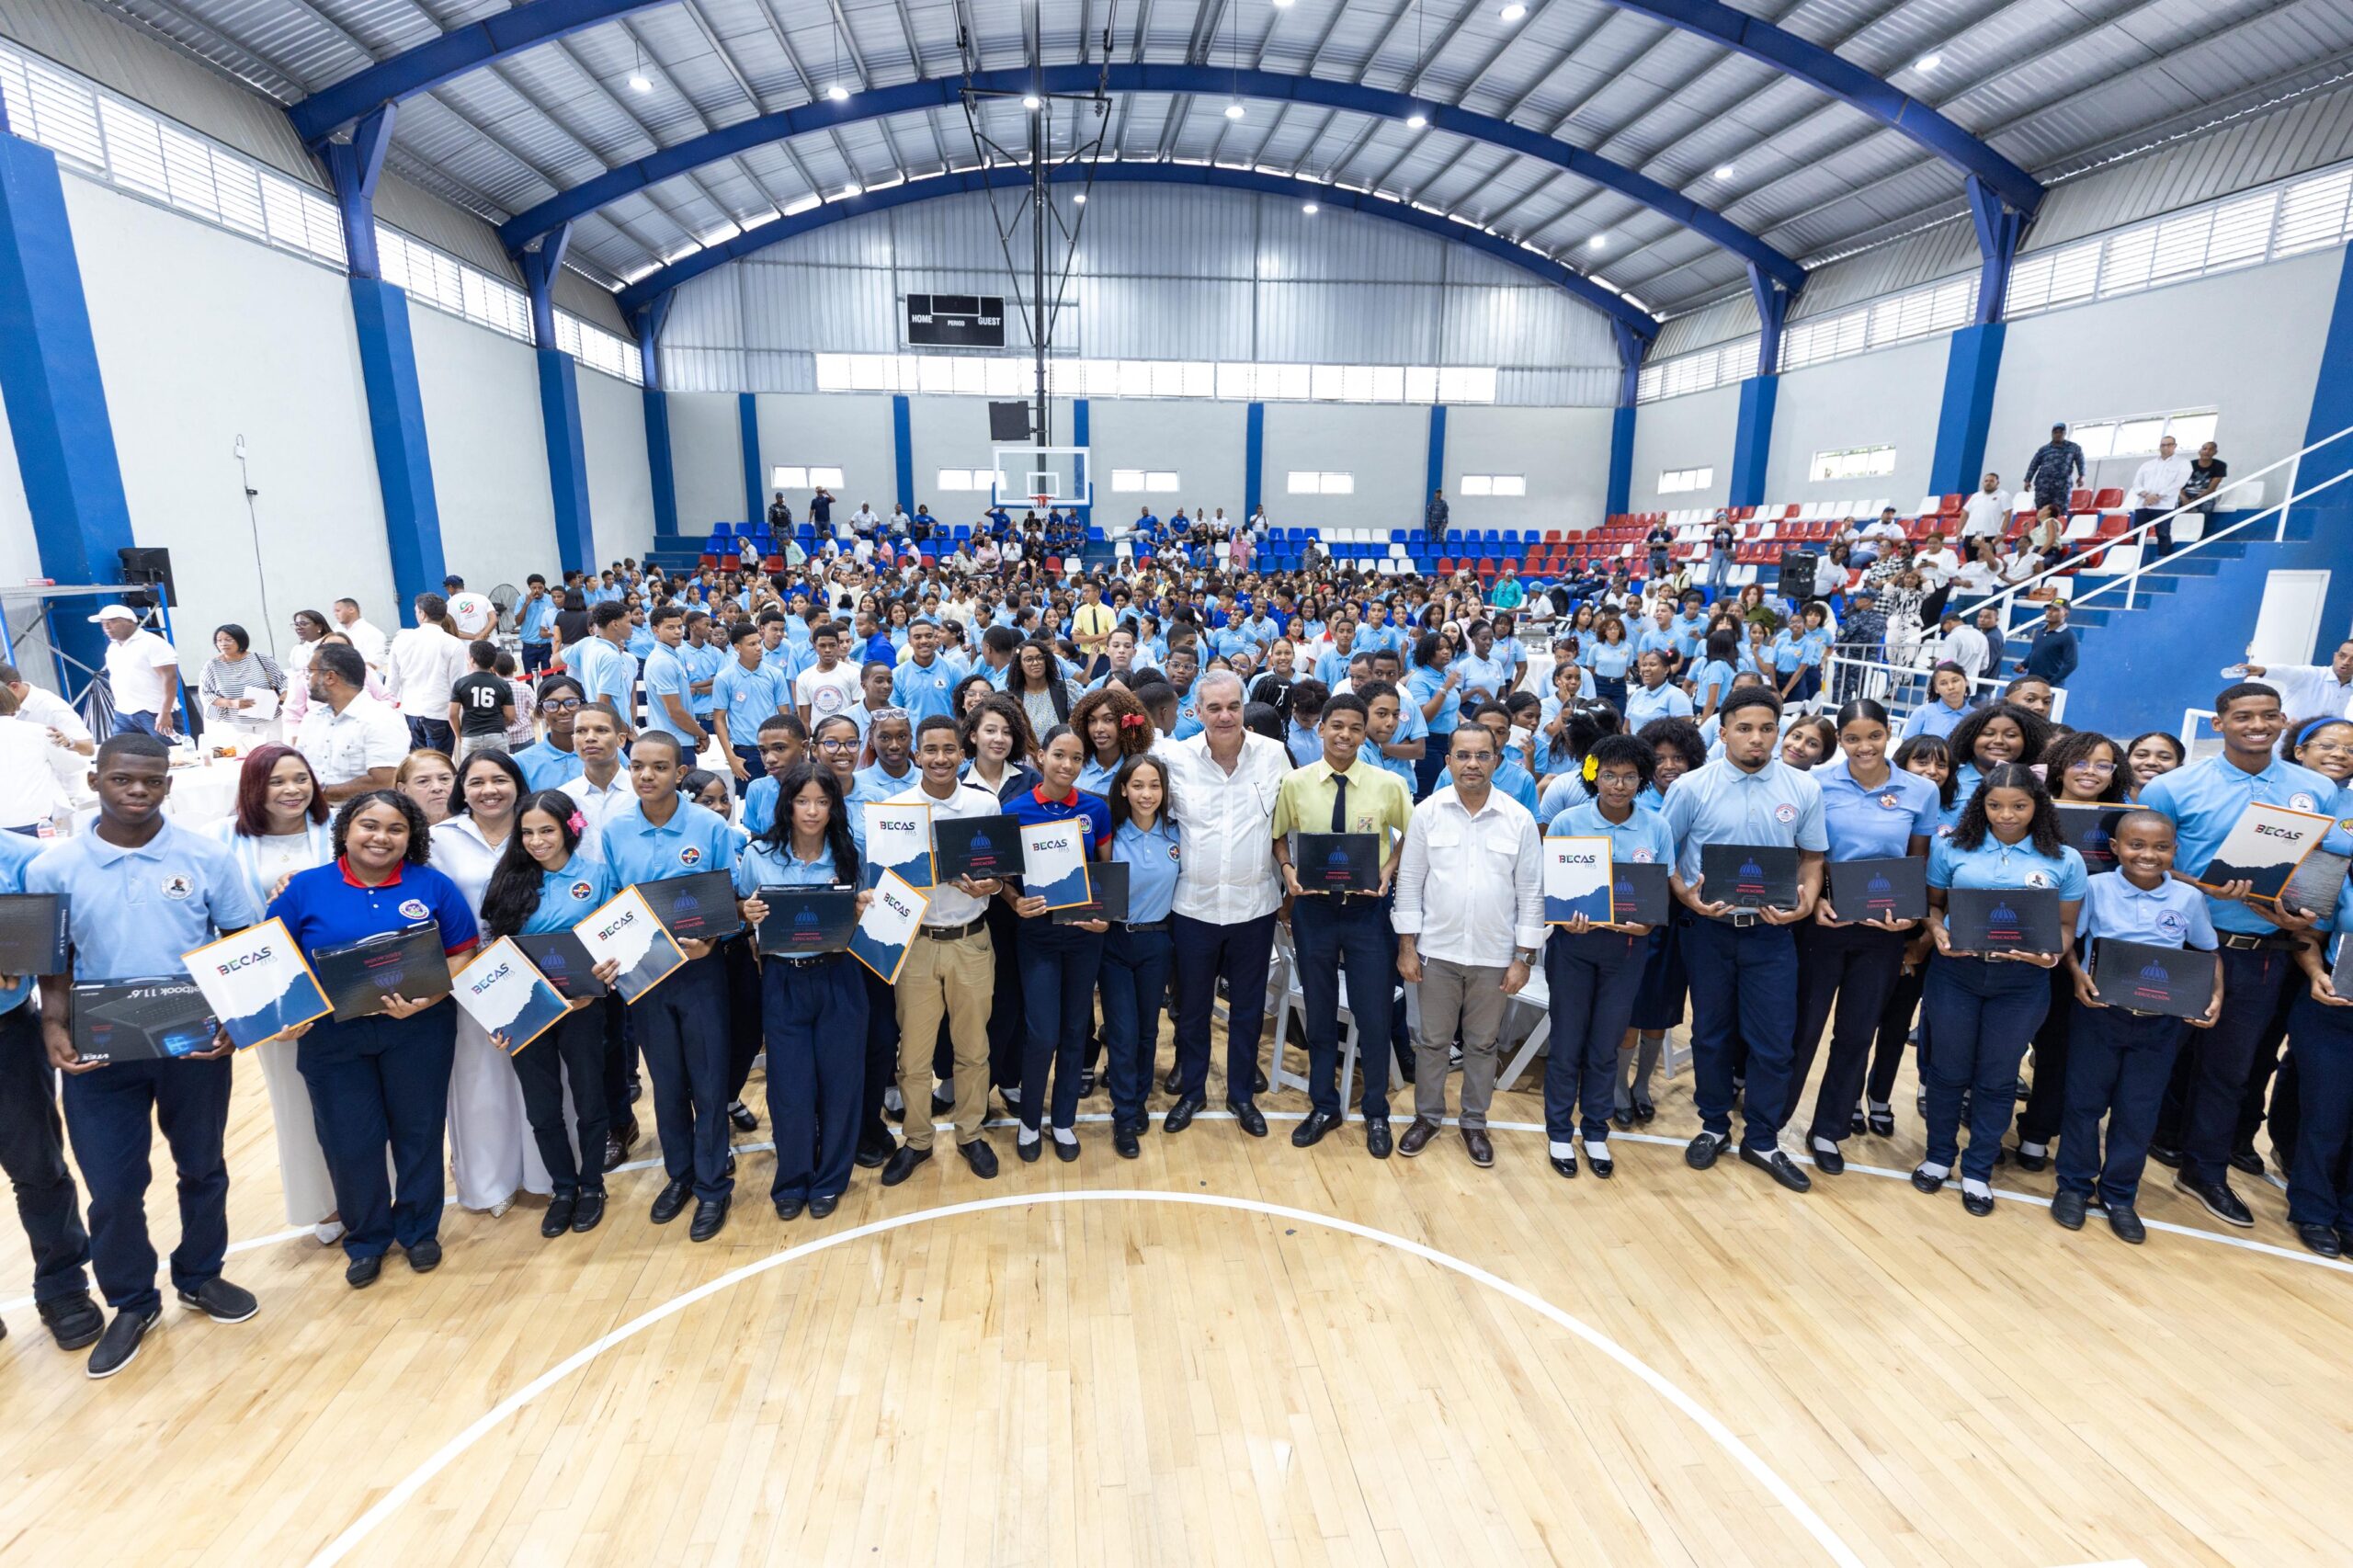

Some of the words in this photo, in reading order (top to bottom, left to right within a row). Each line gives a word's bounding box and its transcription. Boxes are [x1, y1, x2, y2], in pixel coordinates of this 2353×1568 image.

[912, 314, 933, 324] HOME
[977, 317, 1001, 326] GUEST
[471, 686, 495, 708] 16
[880, 821, 915, 831] BECAS
[2255, 824, 2303, 840] BECAS
[1032, 838, 1068, 851] BECAS
[1559, 855, 1596, 863] BECAS
[883, 892, 911, 917] BECAS
[597, 911, 633, 941] BECAS
[217, 946, 272, 975] BECAS
[471, 962, 509, 994] BECAS
[160, 985, 204, 996] etbook
